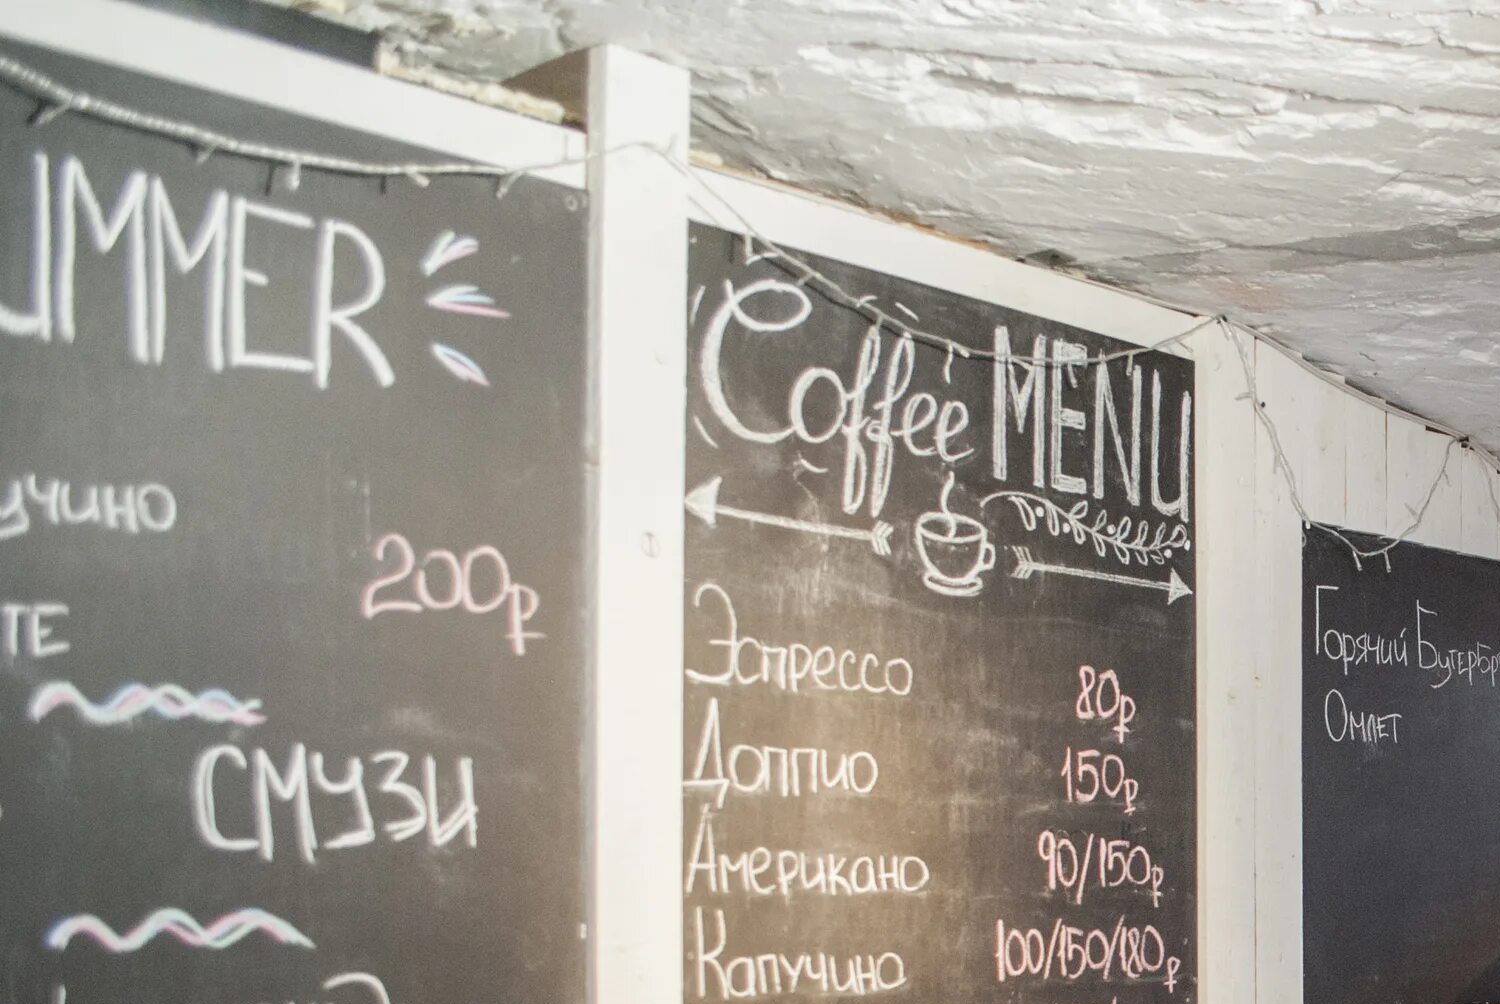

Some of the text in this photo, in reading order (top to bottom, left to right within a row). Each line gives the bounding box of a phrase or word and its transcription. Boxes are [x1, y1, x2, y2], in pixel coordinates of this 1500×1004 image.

[700, 279, 1192, 524] Coffee MENU
[685, 583, 914, 696] Эспрессо
[1315, 585, 1409, 676] Горячий
[194, 743, 479, 863] СМУЗИ
[682, 698, 880, 808] Доппио
[685, 804, 930, 896] Американо
[696, 906, 908, 1000] Капучино
